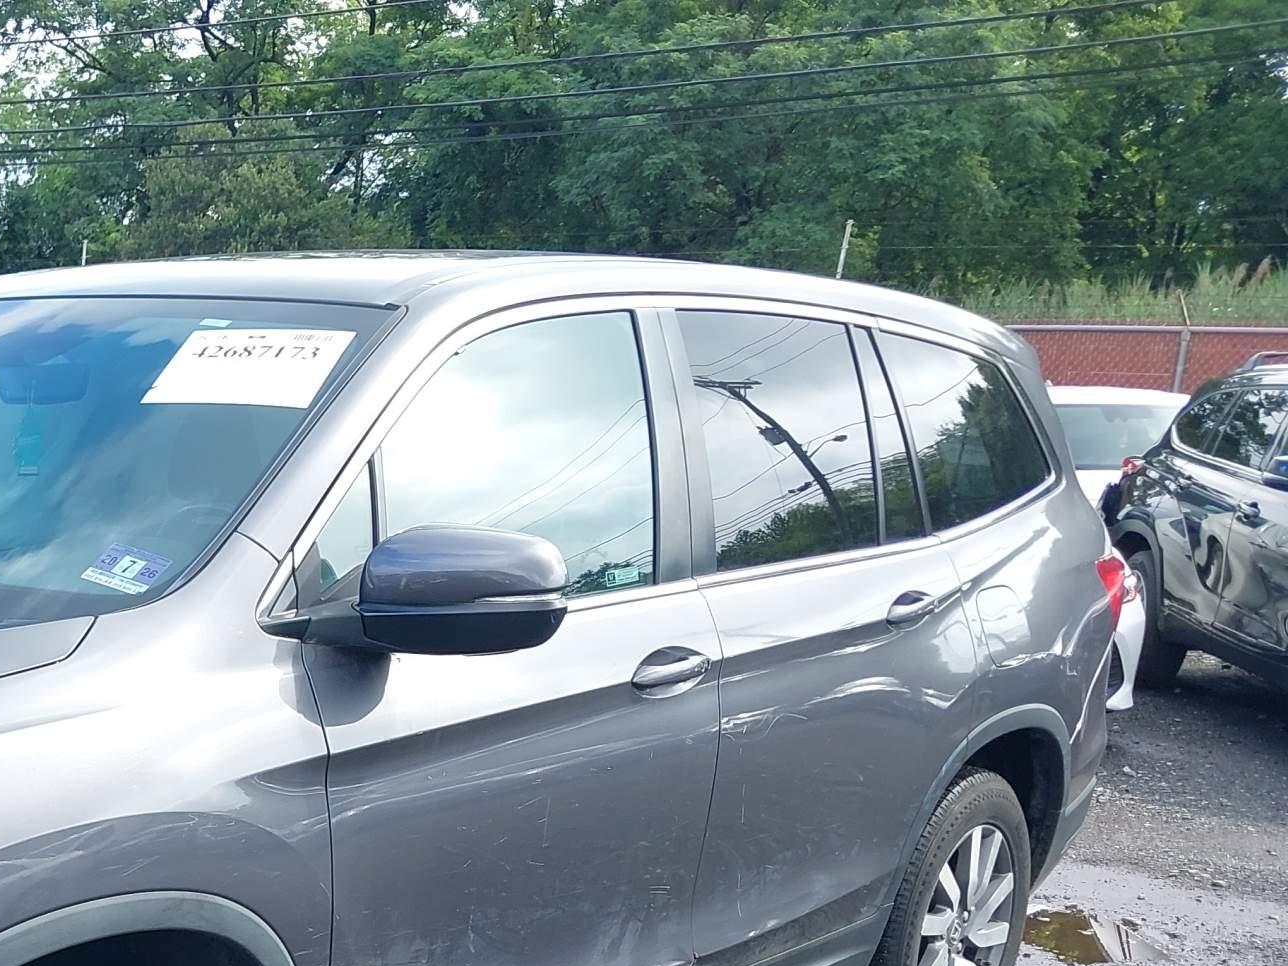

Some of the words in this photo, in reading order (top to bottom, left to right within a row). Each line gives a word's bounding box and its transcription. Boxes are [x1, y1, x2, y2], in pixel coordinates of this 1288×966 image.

[192, 345, 320, 360] 42687173
[101, 554, 118, 566] 20
[122, 559, 137, 573] 7
[140, 567, 159, 579] 26
